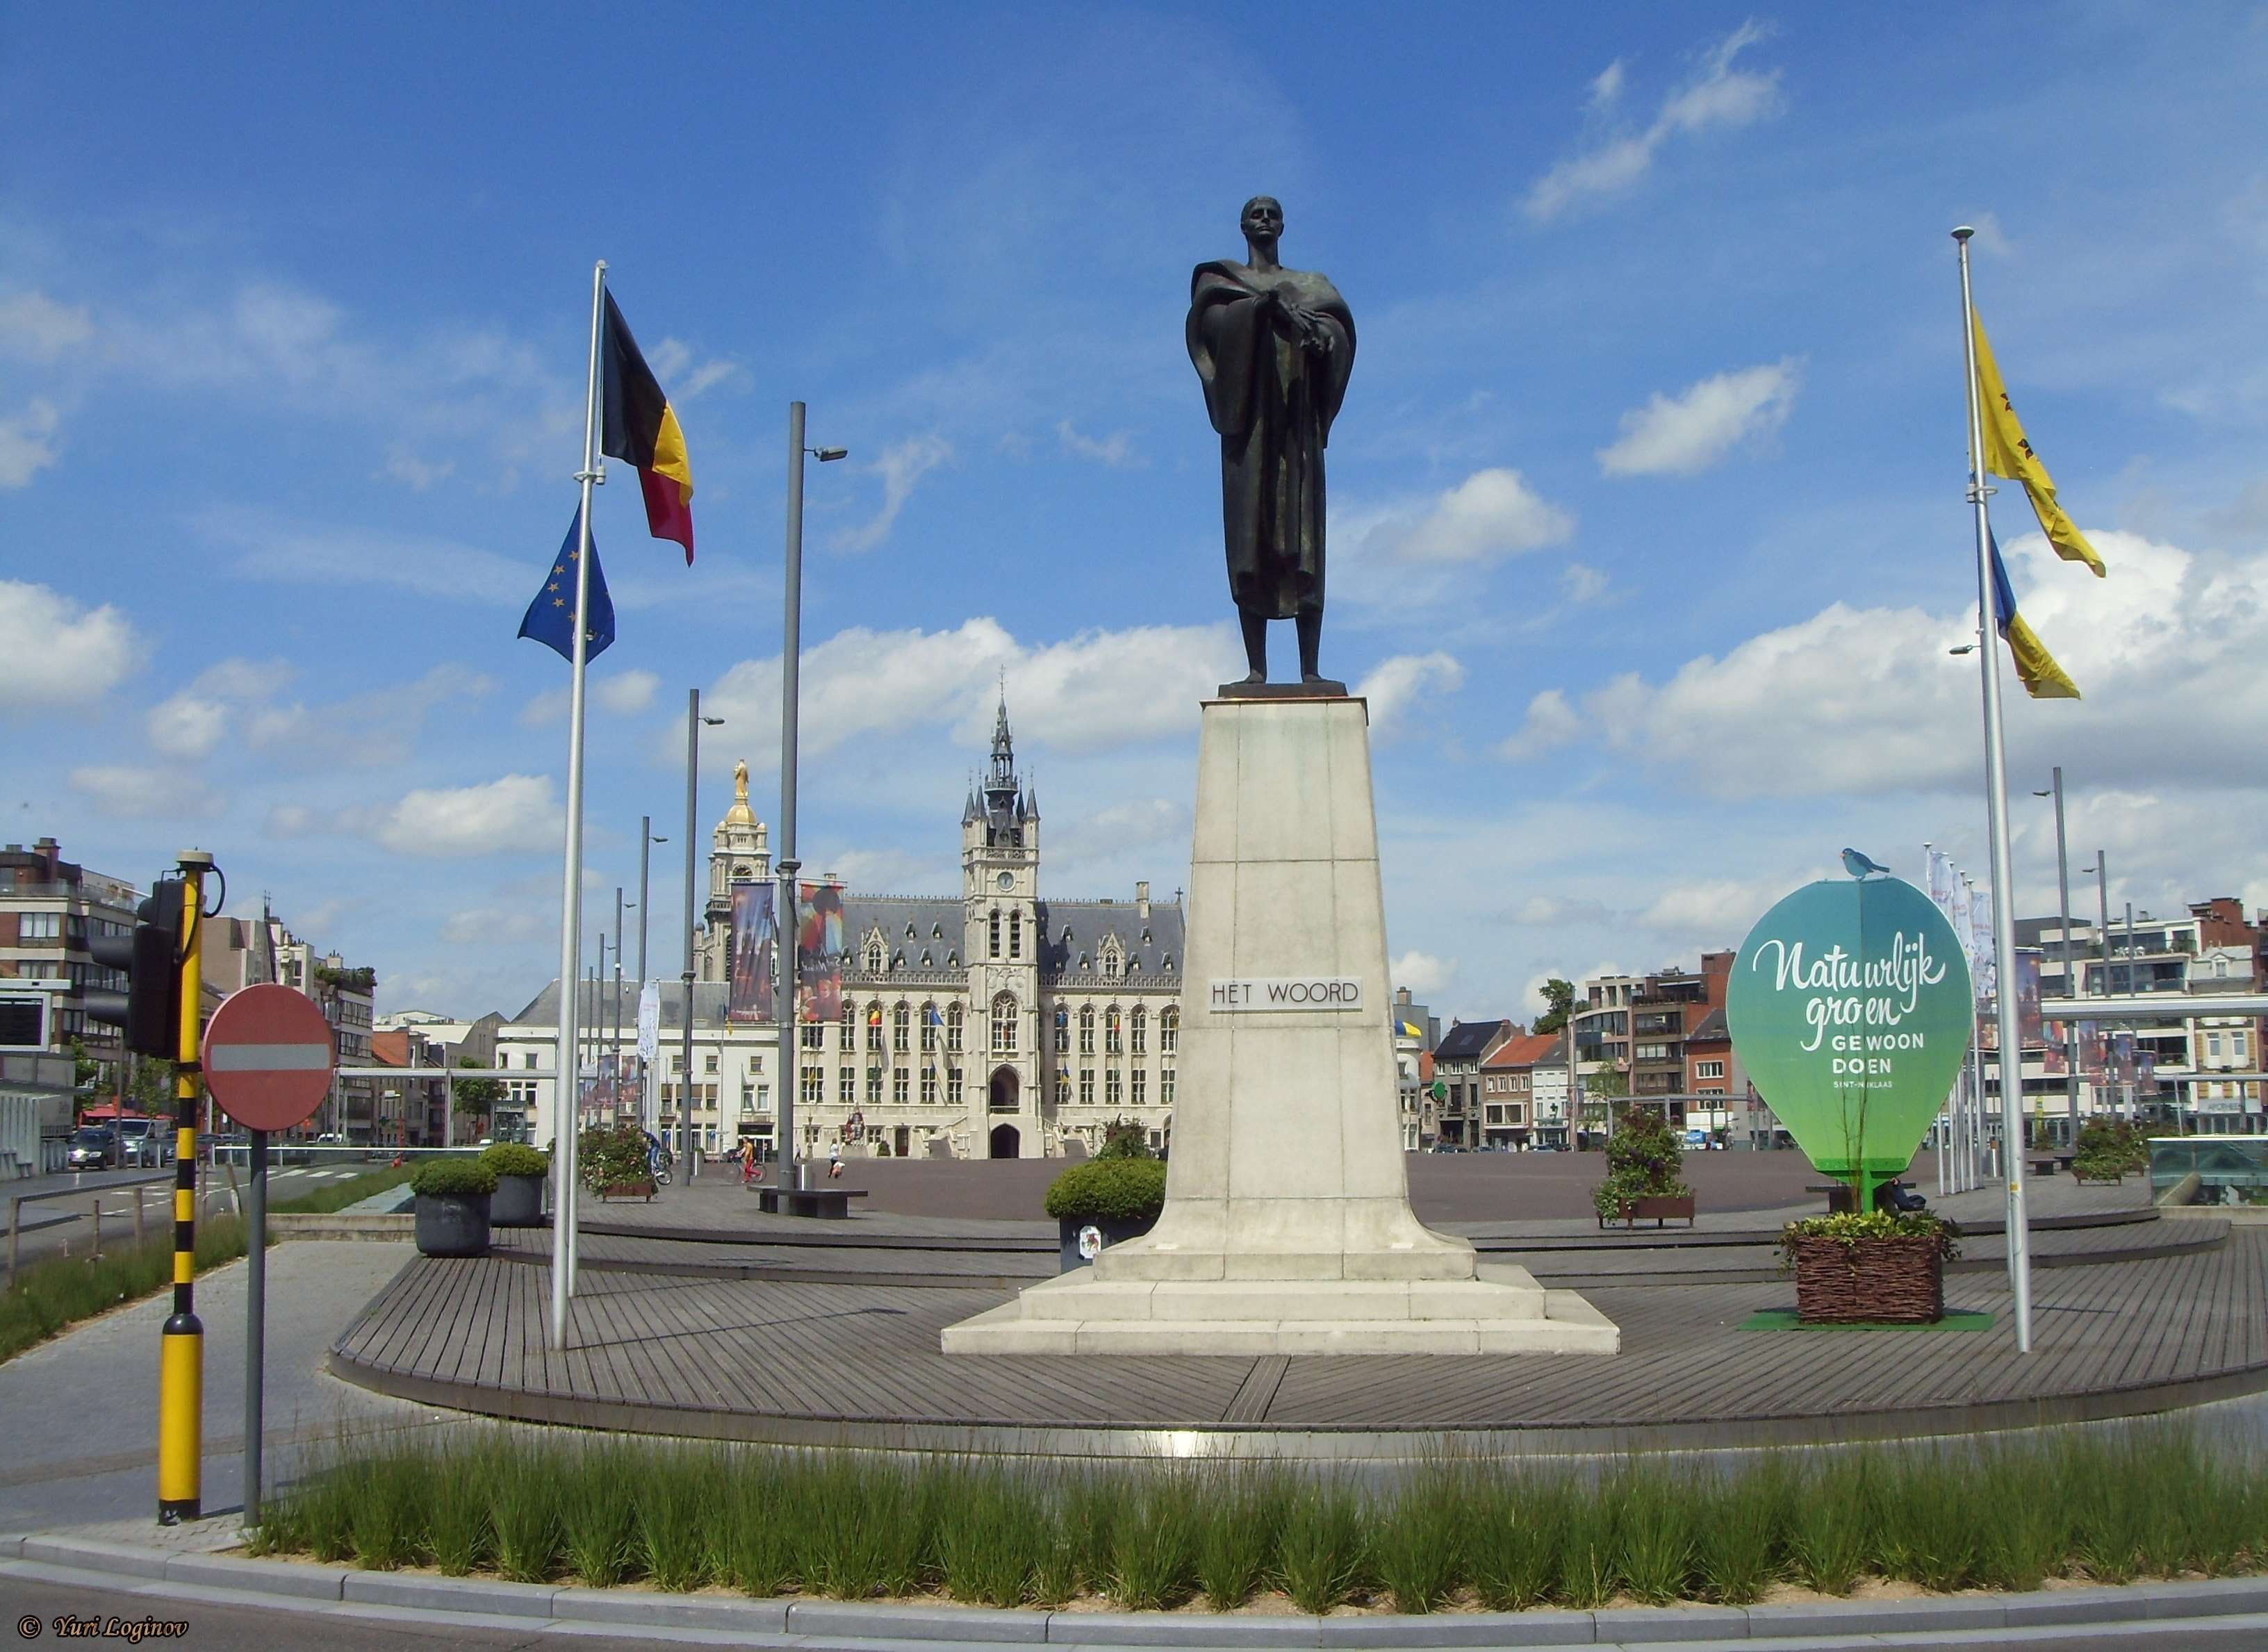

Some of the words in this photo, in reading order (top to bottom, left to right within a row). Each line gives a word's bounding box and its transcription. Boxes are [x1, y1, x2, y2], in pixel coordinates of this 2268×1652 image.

[1752, 931, 1946, 1013] Natuurlijk
[1213, 984, 1251, 1003] HET
[1267, 982, 1358, 1002] WOORD
[1800, 996, 1901, 1051] groen
[1832, 1033, 1923, 1050] GEWOON
[1832, 1058, 1891, 1074] DOEN
